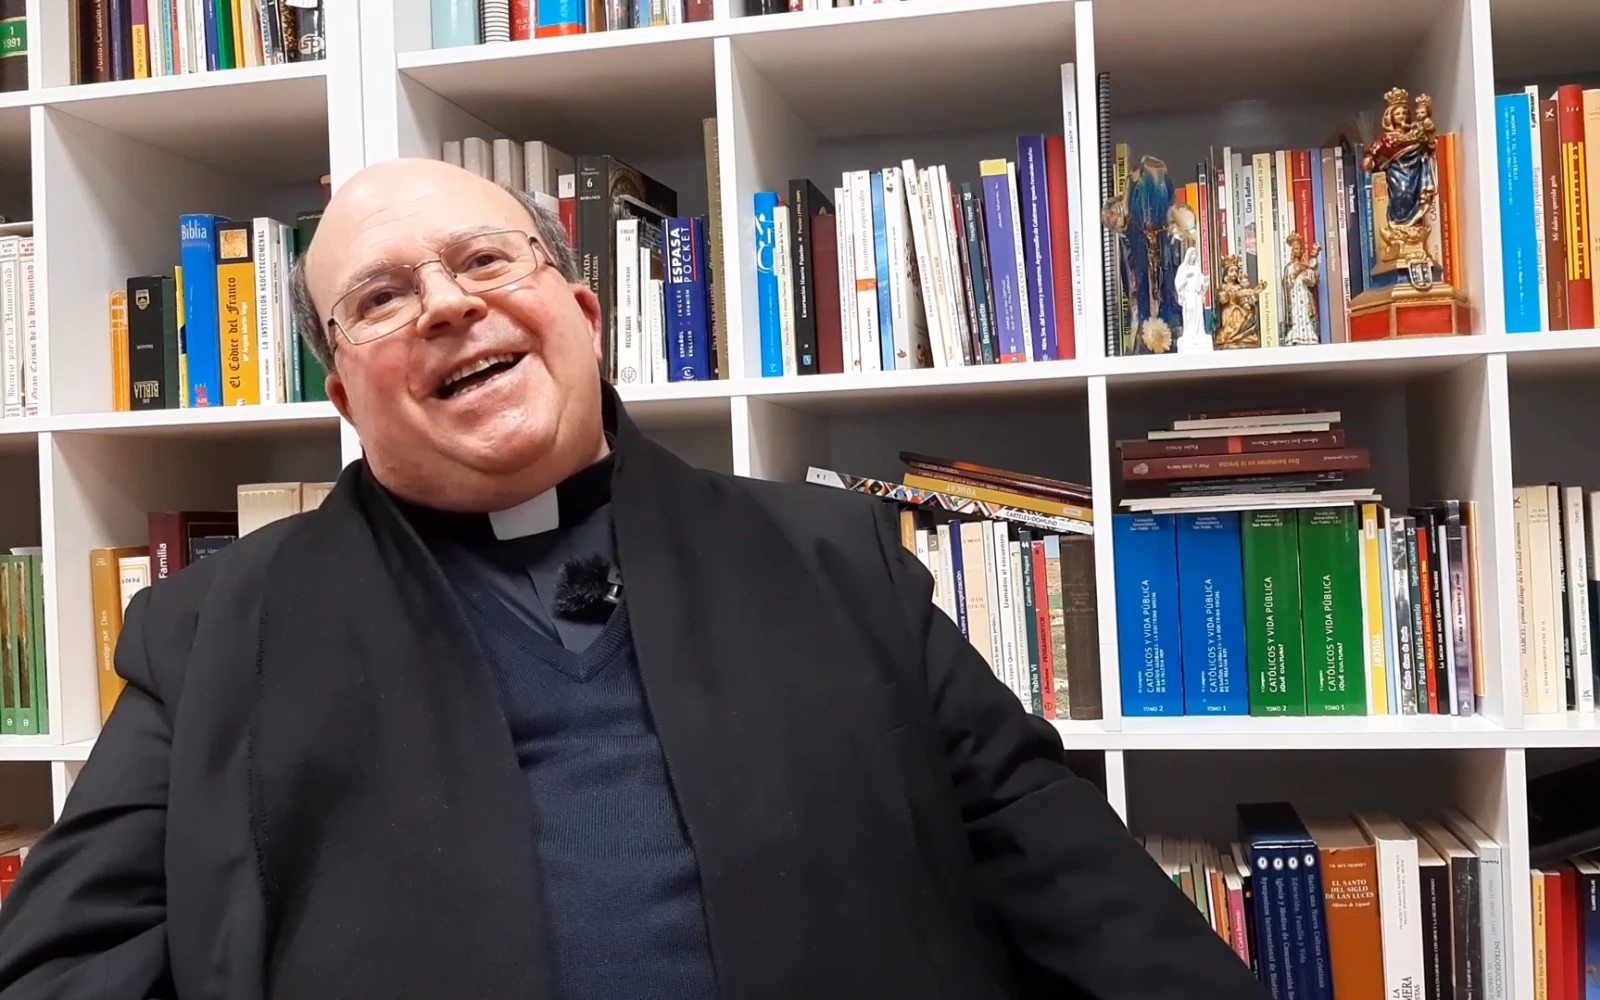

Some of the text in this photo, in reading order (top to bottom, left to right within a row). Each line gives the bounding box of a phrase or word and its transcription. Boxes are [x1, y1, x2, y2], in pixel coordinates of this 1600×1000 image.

[10, 26, 14, 36] 1
[587, 178, 593, 188] 6
[182, 220, 207, 240] Biblia
[670, 228, 683, 284] ESPASA
[681, 227, 693, 282] POCKET
[28, 320, 36, 328] la
[28, 330, 36, 340] de
[225, 277, 240, 388] El Códice del Franco
[979, 303, 990, 344] Bernadette
[28, 344, 37, 373] Crisis
[134, 384, 159, 398] BIBLIA
[945, 484, 977, 497] YOUCAT
[1407, 528, 1415, 536] 25
[159, 543, 168, 579] Familia
[1002, 576, 1010, 608] Llamados
[1141, 580, 1150, 615] PÚBLICA
[1204, 579, 1213, 614] PÚBLICA
[1264, 577, 1273, 613] PÚBLICA
[1322, 575, 1332, 611] PÚBLICA
[100, 610, 108, 625] Dios
[1143, 617, 1152, 637] VIDA
[1206, 616, 1214, 637] VIDA
[1266, 616, 1275, 636] VIDA
[1325, 614, 1334, 634] VIDA
[1372, 634, 1382, 666] YOUCAT
[1414, 604, 1426, 684] Padre María-Eugenio
[1144, 647, 1154, 693] CATÓLICOS
[1207, 647, 1217, 692] CATÓLICOS
[1267, 646, 1277, 692] CATÓLICOS
[1326, 644, 1336, 691] CATÓLICOS
[1030, 670, 1038, 693] Pablo
[1275, 878, 1285, 899] Iglesia
[1307, 874, 1316, 893] Hacia
[1260, 877, 1276, 972] Symposium Internacional de
[1280, 907, 1289, 930] Medios
[1311, 909, 1320, 929] Nueva
[1282, 932, 1290, 940] de
[1294, 915, 1304, 940] Familia
[1299, 948, 1307, 963] Vida
[1313, 931, 1322, 956] Cultura
[1283, 942, 1294, 990] Comunicación
[1316, 957, 1326, 988] Cristiana
[1392, 988, 1400, 998] LA
